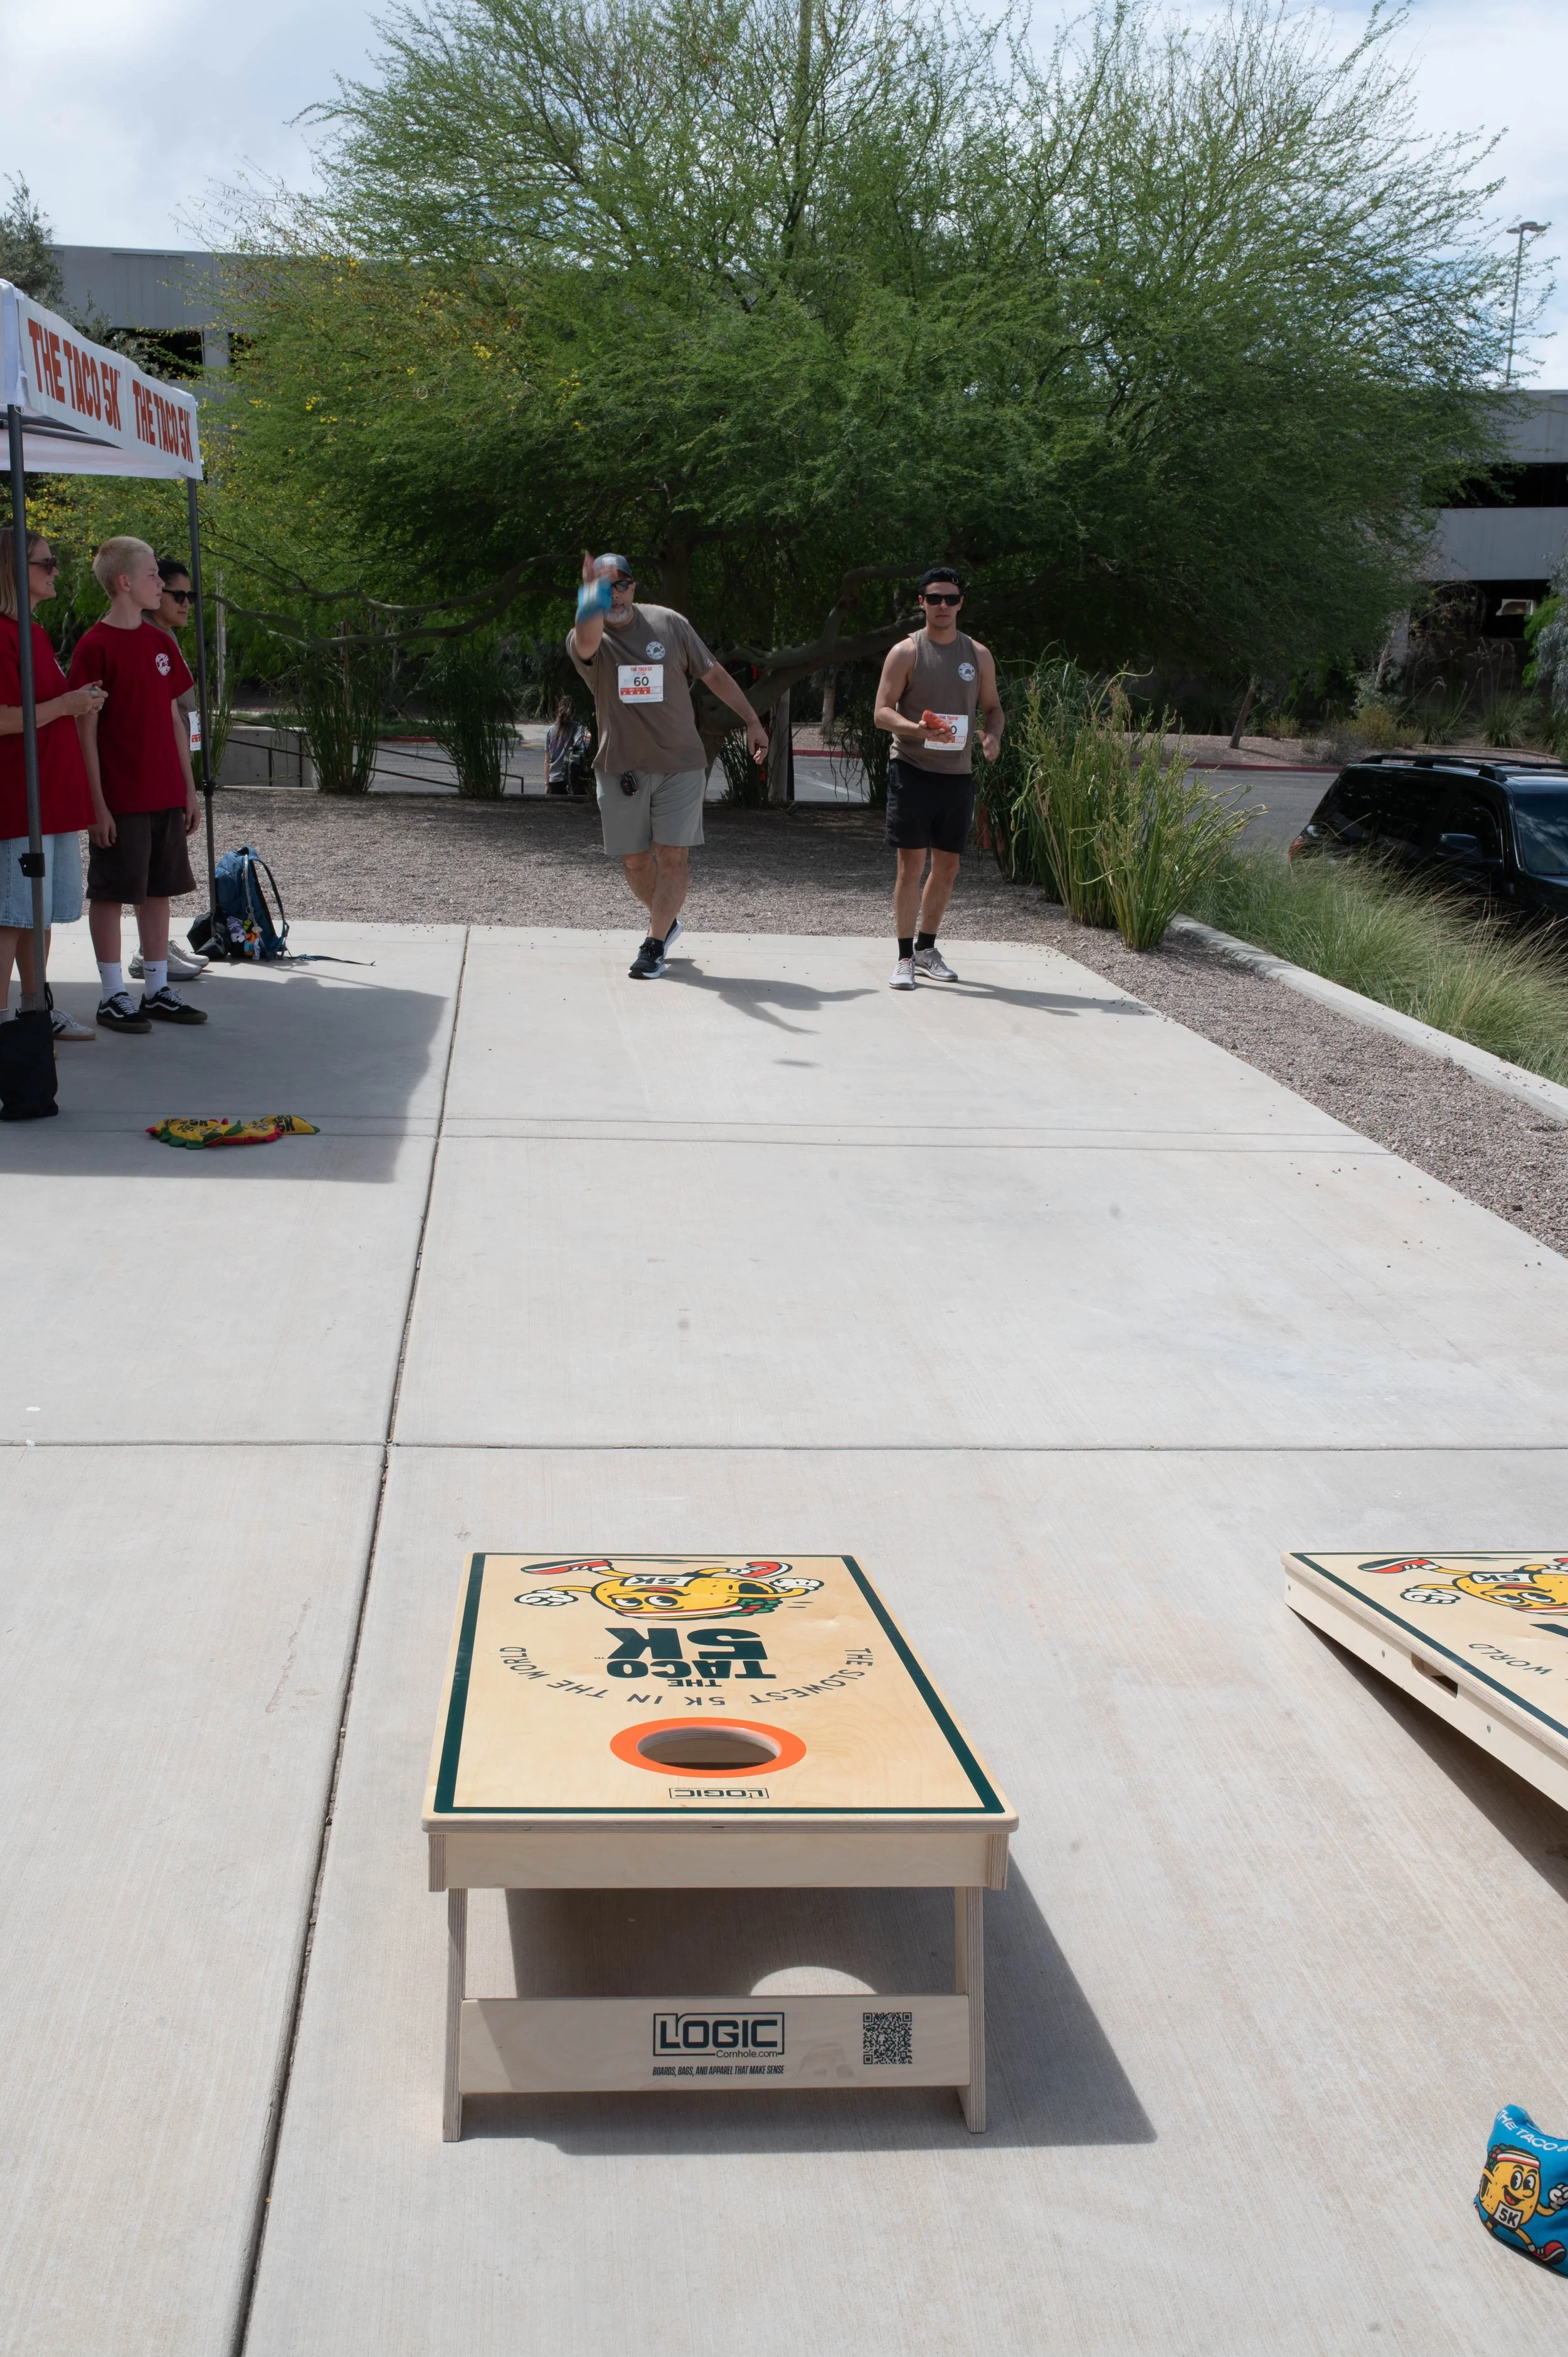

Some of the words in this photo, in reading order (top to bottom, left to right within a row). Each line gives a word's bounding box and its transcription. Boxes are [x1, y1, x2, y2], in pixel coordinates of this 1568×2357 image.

[28, 317, 65, 403] THE
[63, 339, 101, 422] TACO
[100, 361, 121, 432] 5K
[132, 380, 156, 445] THE
[153, 393, 179, 457] TACO
[178, 407, 193, 463] 5K
[634, 677, 649, 686] 60
[635, 1577, 681, 1585] 5K
[605, 1627, 768, 1659] 5K
[499, 1646, 551, 1679] WORLD
[844, 1647, 874, 1666] THE
[1468, 1643, 1553, 1674] WORLD
[607, 1660, 776, 1679] TACO
[546, 1679, 609, 1698] THE
[668, 1679, 722, 1687] THE
[749, 1669, 866, 1703] SLOWEST
[627, 1693, 663, 1704] IN
[684, 1696, 726, 1706] 5K
[660, 2019, 778, 2049] LOGIC
[716, 2049, 778, 2058] Cornhole.com
[652, 2066, 677, 2077] BOARDS,
[677, 2066, 694, 2077] BAGS,
[695, 2066, 708, 2075] AND
[708, 2066, 733, 2075] APPAREL
[734, 2065, 749, 2075] THAT
[749, 2065, 766, 2075] MAKE
[766, 2065, 785, 2074] SENSE
[1496, 2109, 1518, 2131] THE
[1516, 2128, 1558, 2151] TACO
[1498, 2207, 1518, 2227] 5K
